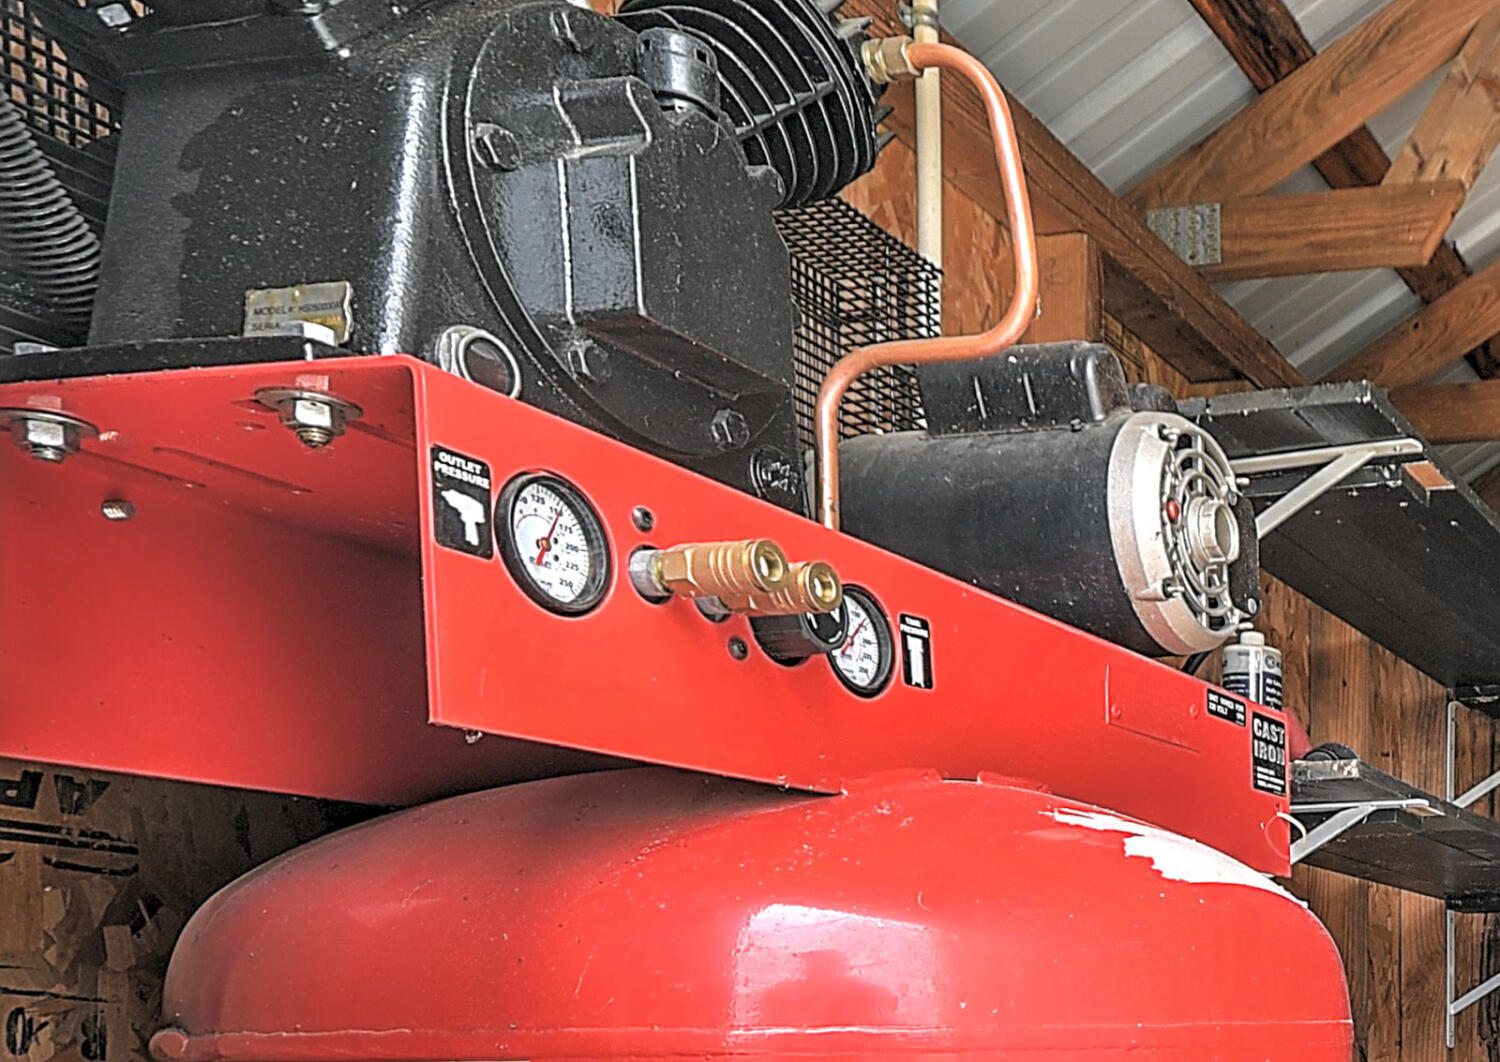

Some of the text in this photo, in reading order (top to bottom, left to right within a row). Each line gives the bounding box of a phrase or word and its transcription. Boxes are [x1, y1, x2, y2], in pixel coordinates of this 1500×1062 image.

[438, 452, 482, 475] OUTLET
[434, 461, 490, 489] PRESSURE
[530, 493, 546, 505] 125
[559, 523, 573, 534] 175
[565, 542, 580, 553] 200
[565, 561, 580, 571] 225
[559, 578, 574, 589] 250
[1253, 717, 1285, 745] CAST
[1253, 739, 1285, 766] IRON
